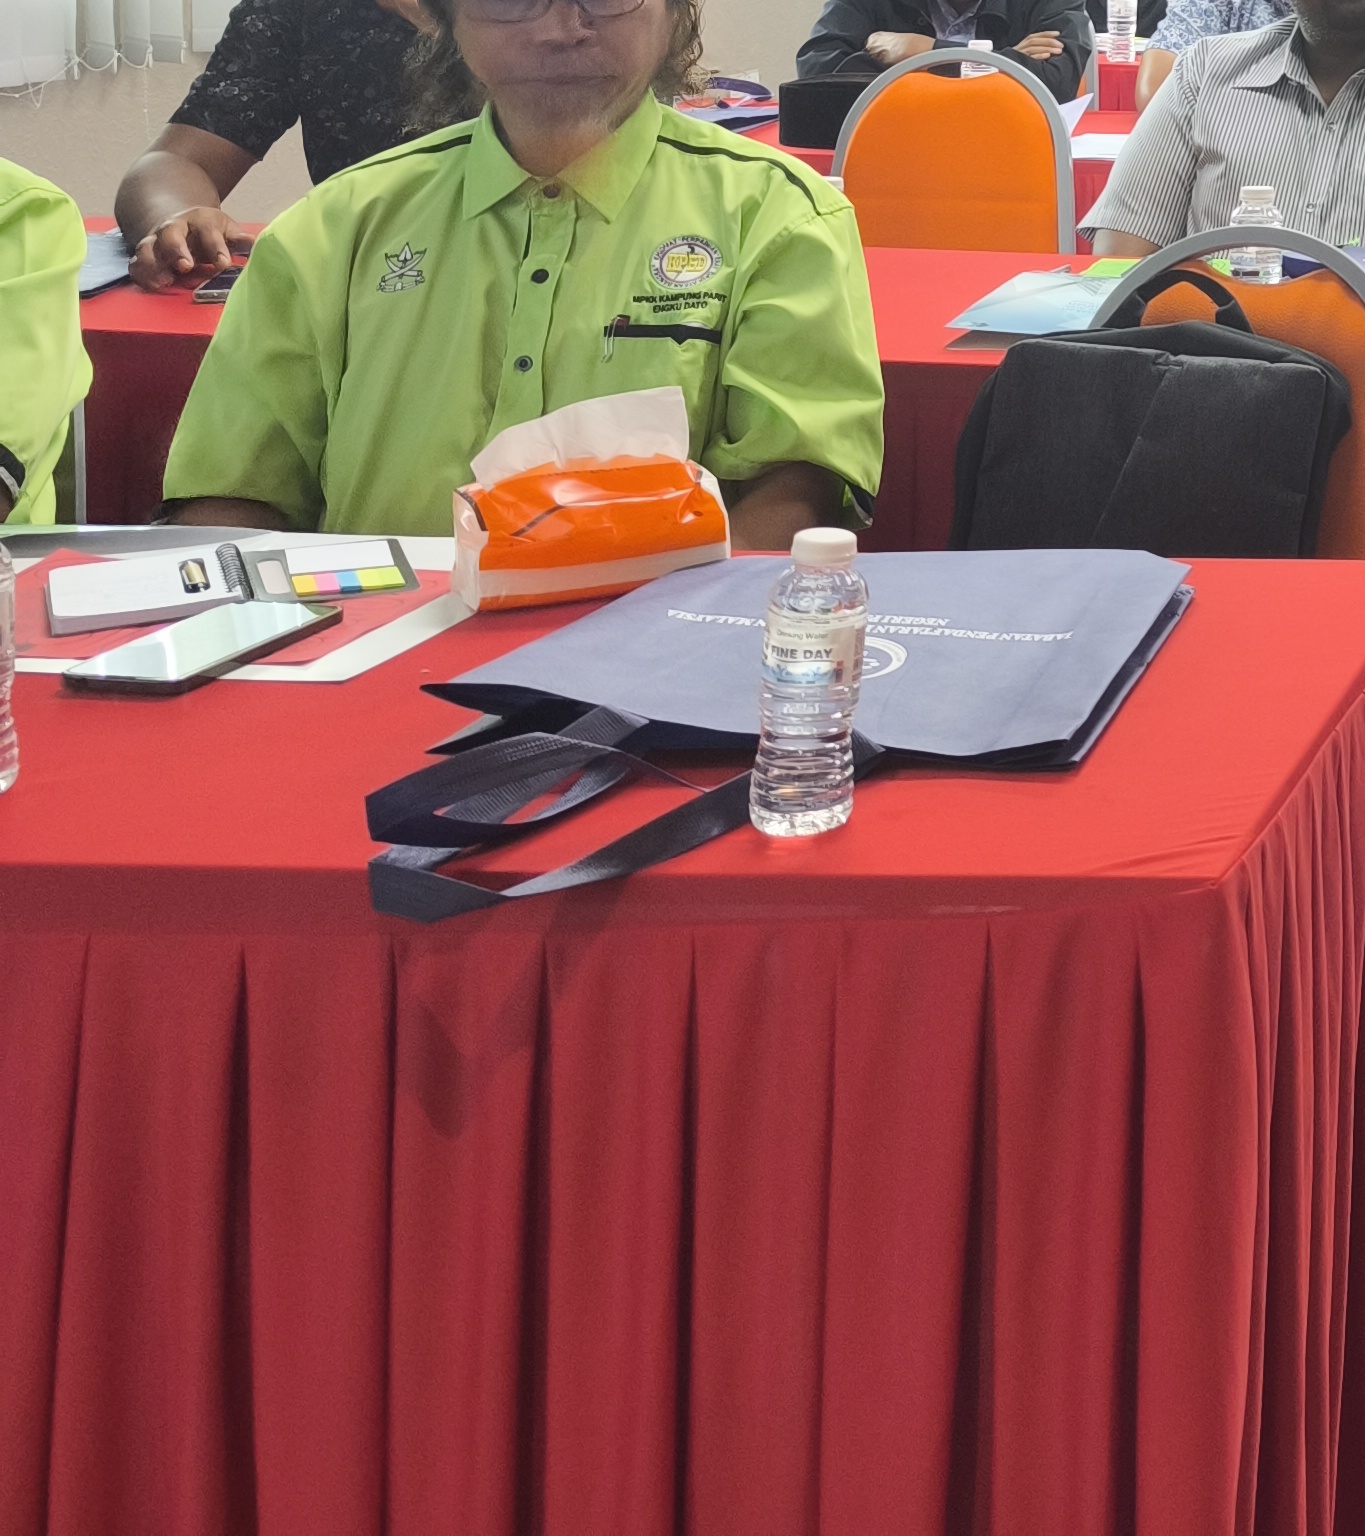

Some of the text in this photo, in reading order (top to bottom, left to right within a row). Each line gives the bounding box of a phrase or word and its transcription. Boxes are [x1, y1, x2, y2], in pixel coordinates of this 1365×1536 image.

[658, 292, 701, 303] KAMPUNG
[703, 291, 728, 304] PARIT
[653, 301, 708, 314] ENGKU DATO
[999, 630, 1075, 642] JABATAN
[771, 645, 833, 660] FINE DAY
